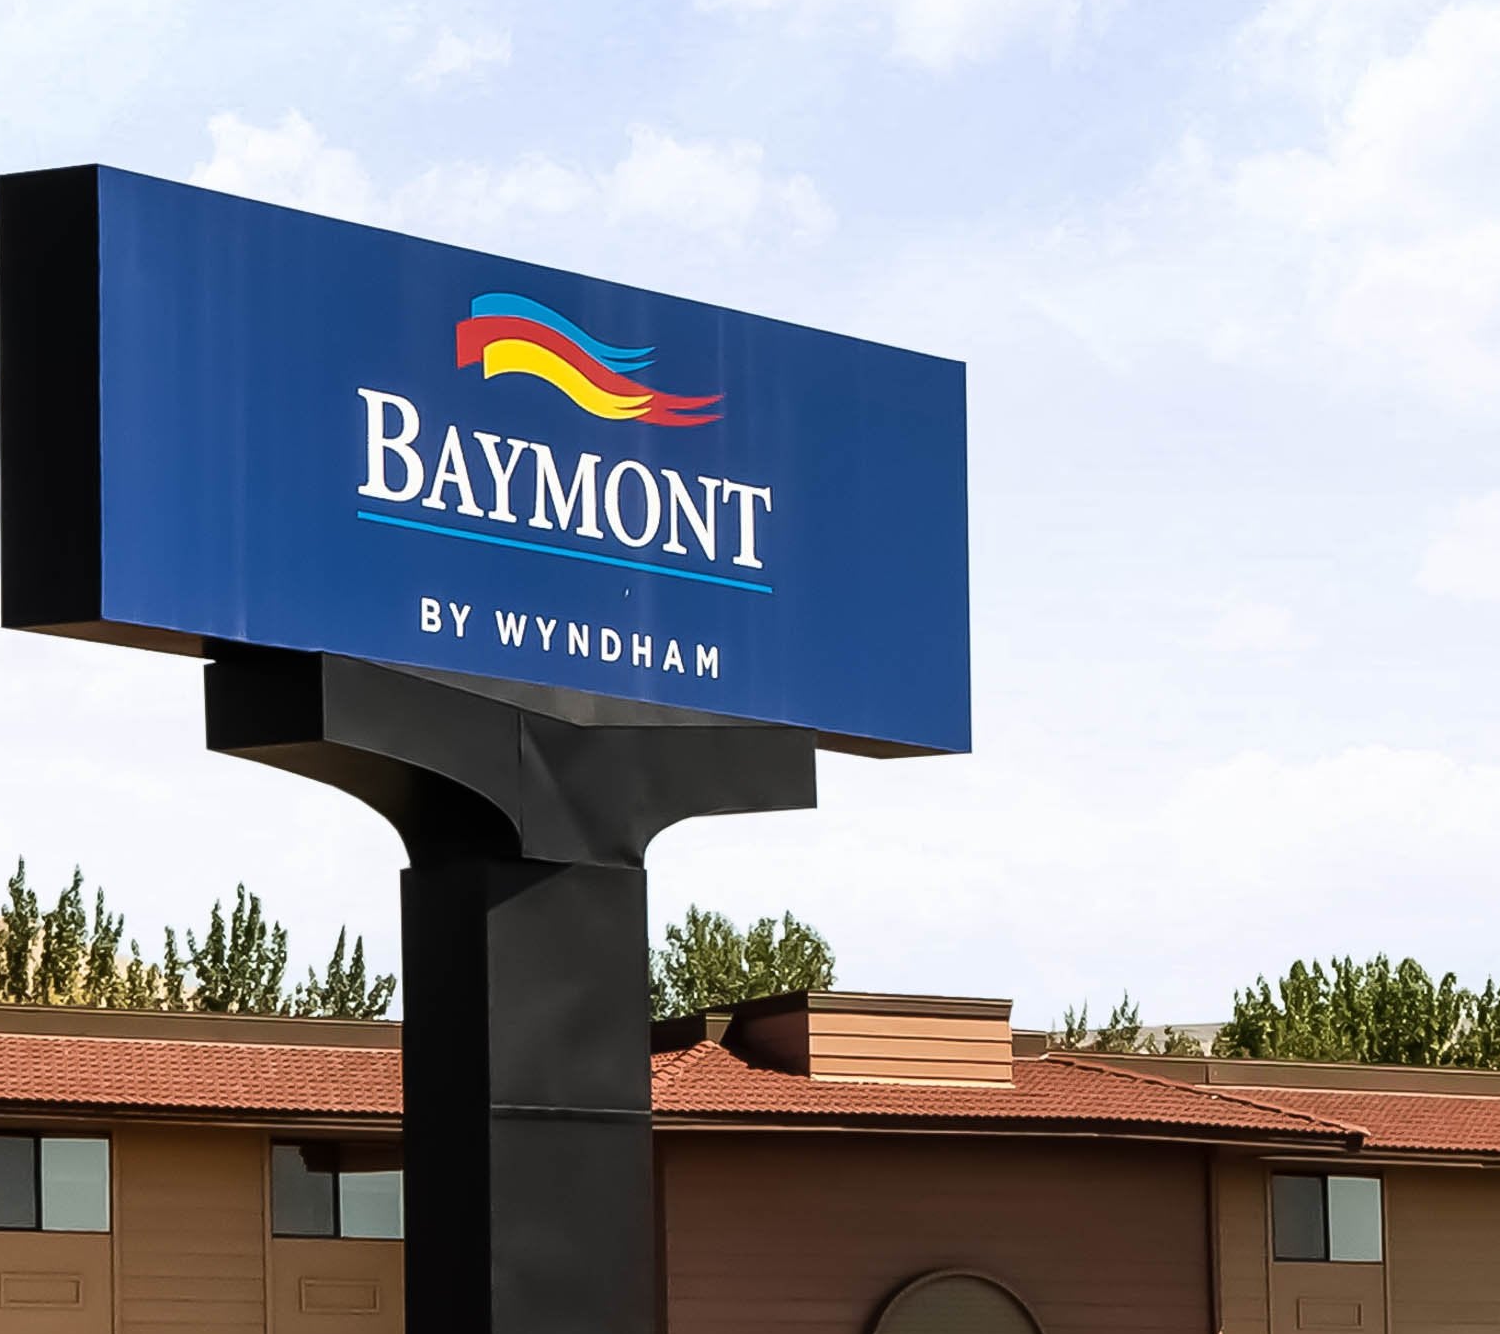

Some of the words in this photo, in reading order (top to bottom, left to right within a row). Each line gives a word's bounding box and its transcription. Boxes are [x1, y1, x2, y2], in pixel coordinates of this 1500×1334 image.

[357, 387, 772, 569] BAYMONT
[420, 597, 471, 638] BY
[495, 610, 719, 679] WYNDHAM
